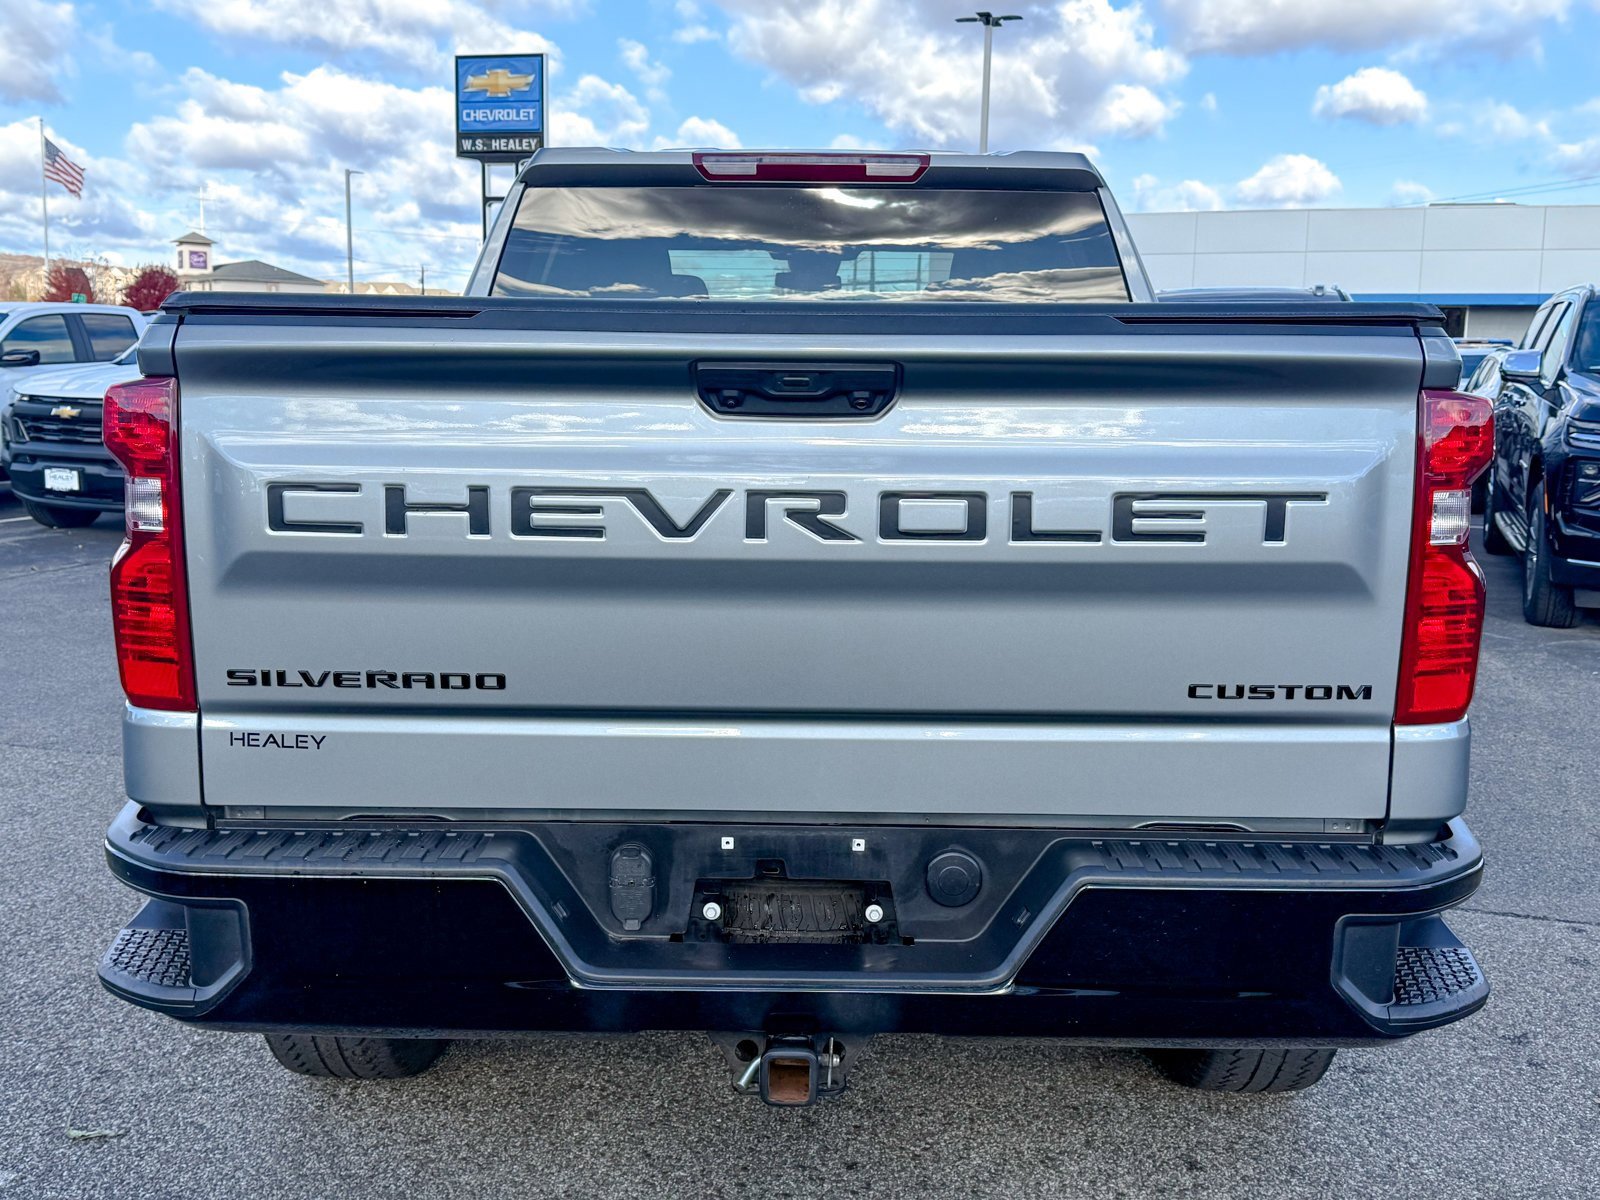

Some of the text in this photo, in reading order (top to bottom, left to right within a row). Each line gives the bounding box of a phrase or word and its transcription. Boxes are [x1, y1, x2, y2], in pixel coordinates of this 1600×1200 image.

[462, 108, 535, 121] CHEVROLET
[461, 138, 538, 151] W.S. HEALEY
[265, 482, 1330, 545] CHEVROLET
[226, 668, 507, 690] SILVERADO
[1187, 683, 1373, 700] CUSTOM
[229, 731, 327, 750] HEALEY
